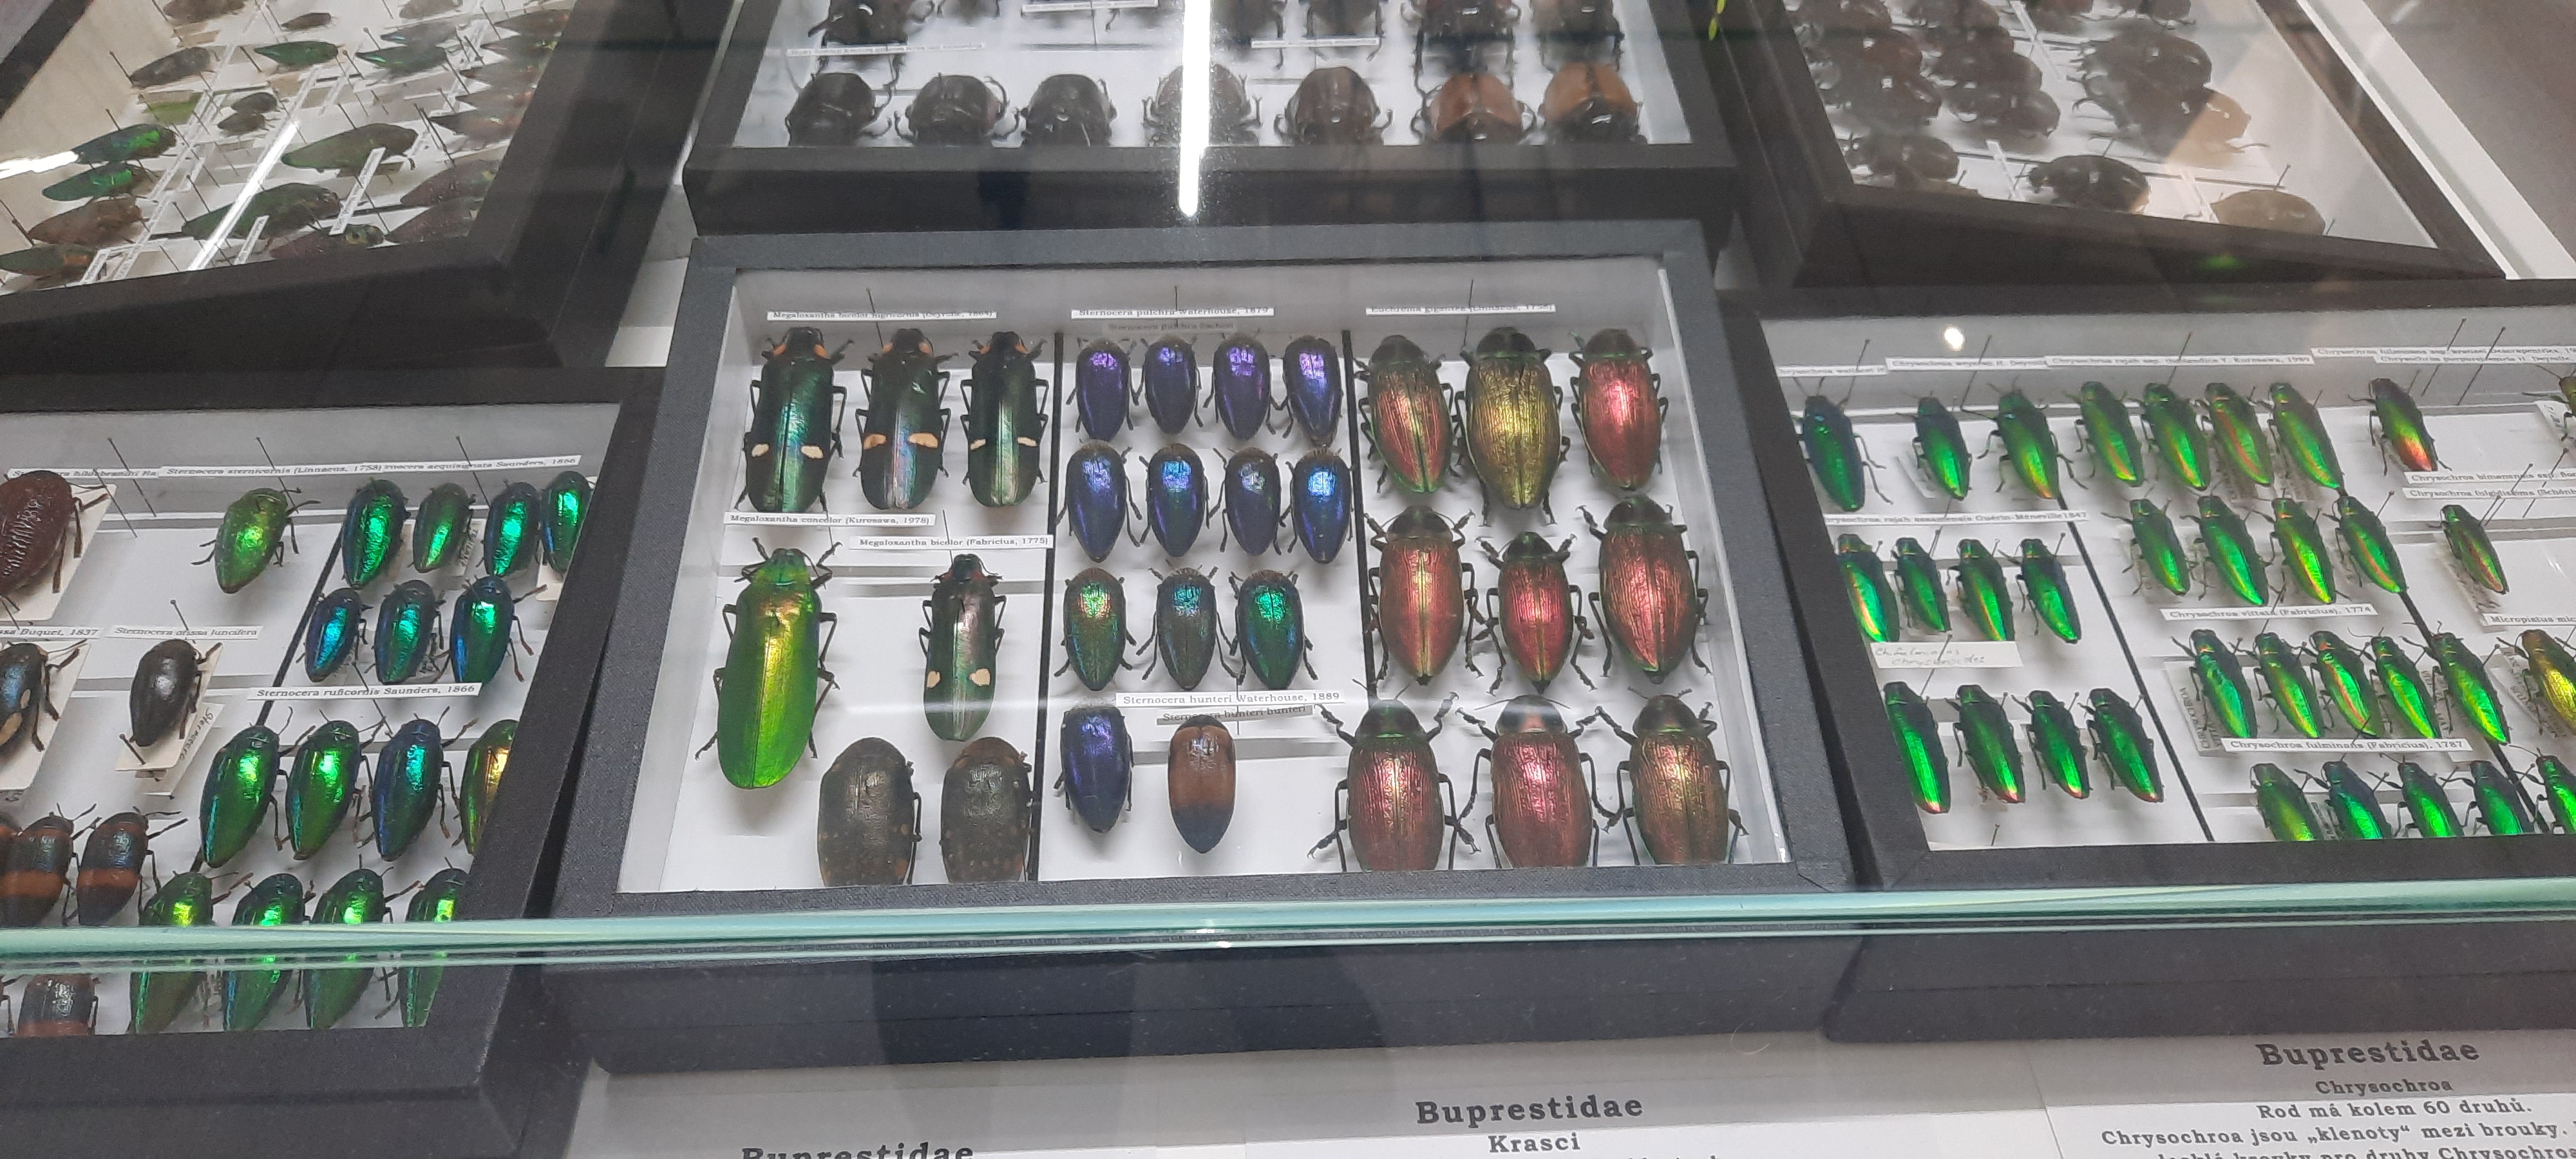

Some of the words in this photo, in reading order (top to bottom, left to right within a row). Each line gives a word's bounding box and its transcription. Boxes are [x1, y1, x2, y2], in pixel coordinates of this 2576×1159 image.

[730, 514, 797, 523] Megaloxantha
[859, 538, 927, 547] Megaloxantha
[931, 538, 962, 546] bicolor
[256, 688, 319, 697] Sternocera
[448, 684, 475, 693] 1866
[1123, 695, 1186, 704] Sternocera
[1189, 694, 1232, 704] hunteri
[1236, 693, 1307, 703] Waterhouse,
[1312, 692, 1340, 701] 1889
[1267, 705, 1306, 715] hunteri
[2255, 1039, 2479, 1071] Buprestidae
[2315, 1079, 2454, 1097] Chrysochroa
[1416, 1094, 1643, 1129] Buprestidae
[2256, 1103, 2302, 1119] Rod
[2308, 1103, 2342, 1118] má
[2347, 1102, 2417, 1117] kolem
[2423, 1100, 2451, 1115] 60
[2459, 1097, 2532, 1114] druhů.
[1488, 1132, 1582, 1153] Krasci
[2101, 1128, 2244, 1149] Chrysochroa
[2250, 1127, 2299, 1147] jsou
[2307, 1124, 2410, 1144] „klenoty“
[2420, 1122, 2476, 1138] mezi
[2478, 1121, 2568, 1140] brouky.
